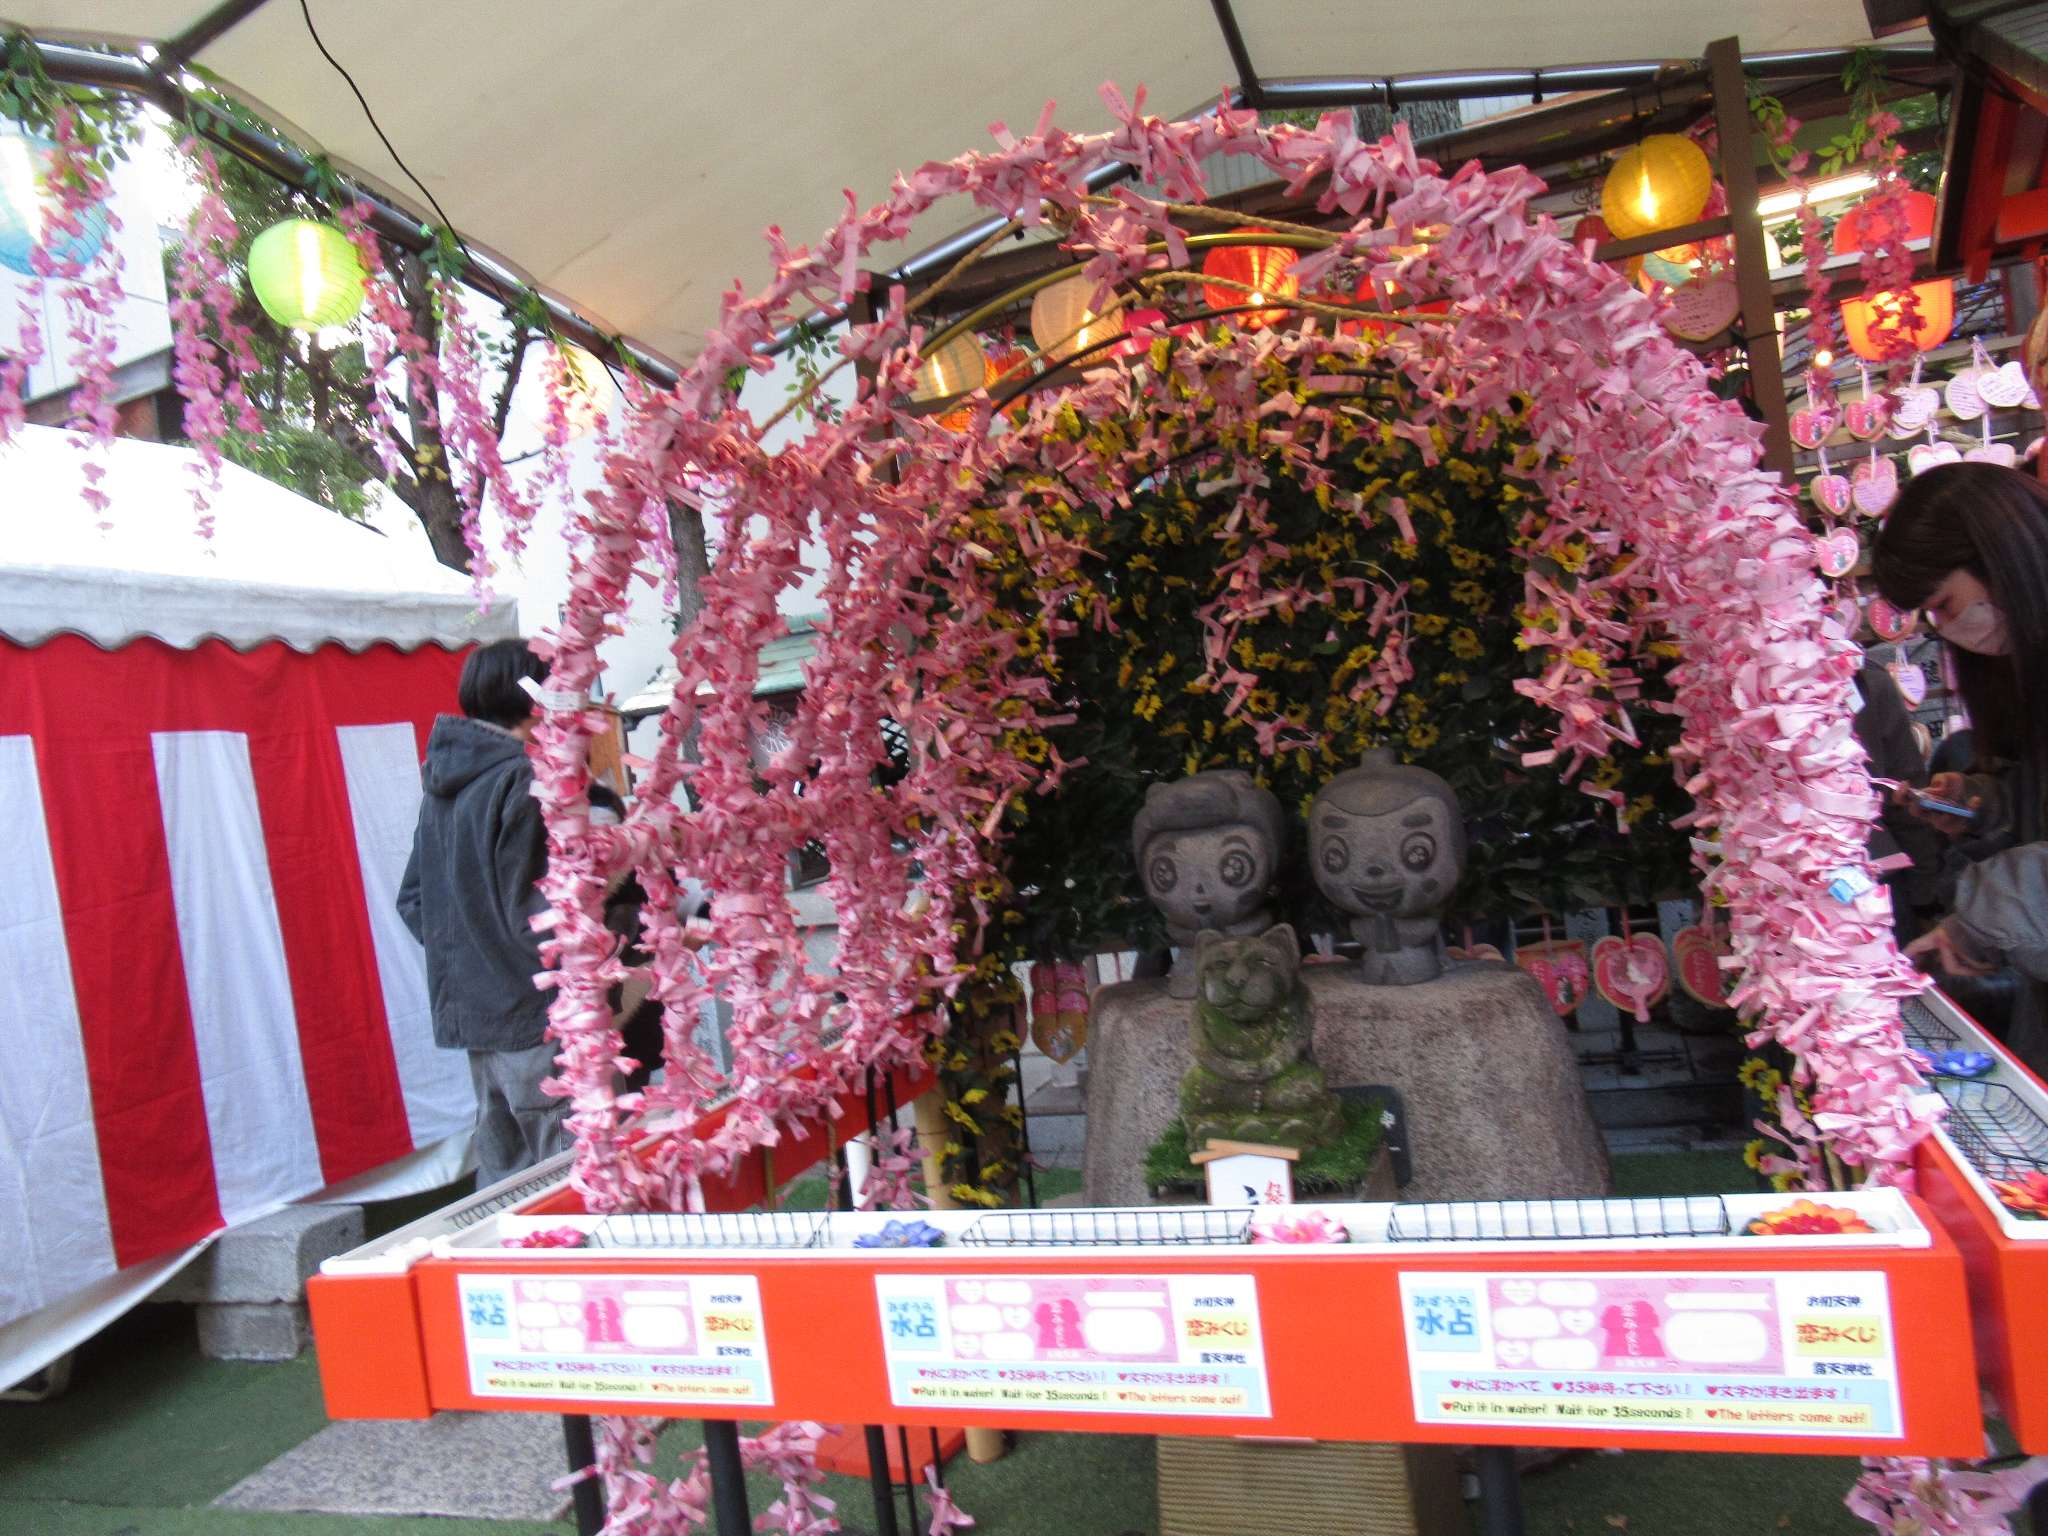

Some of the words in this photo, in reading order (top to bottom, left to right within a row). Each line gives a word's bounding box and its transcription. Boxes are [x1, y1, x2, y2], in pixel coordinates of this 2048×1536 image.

[470, 1302, 505, 1325] 水占
[889, 1313, 935, 1337] 水占
[1415, 1308, 1474, 1335] 水占
[1452, 1400, 1473, 1413] Put
[1557, 1403, 1581, 1416] Wait
[1718, 1408, 1741, 1420] The
